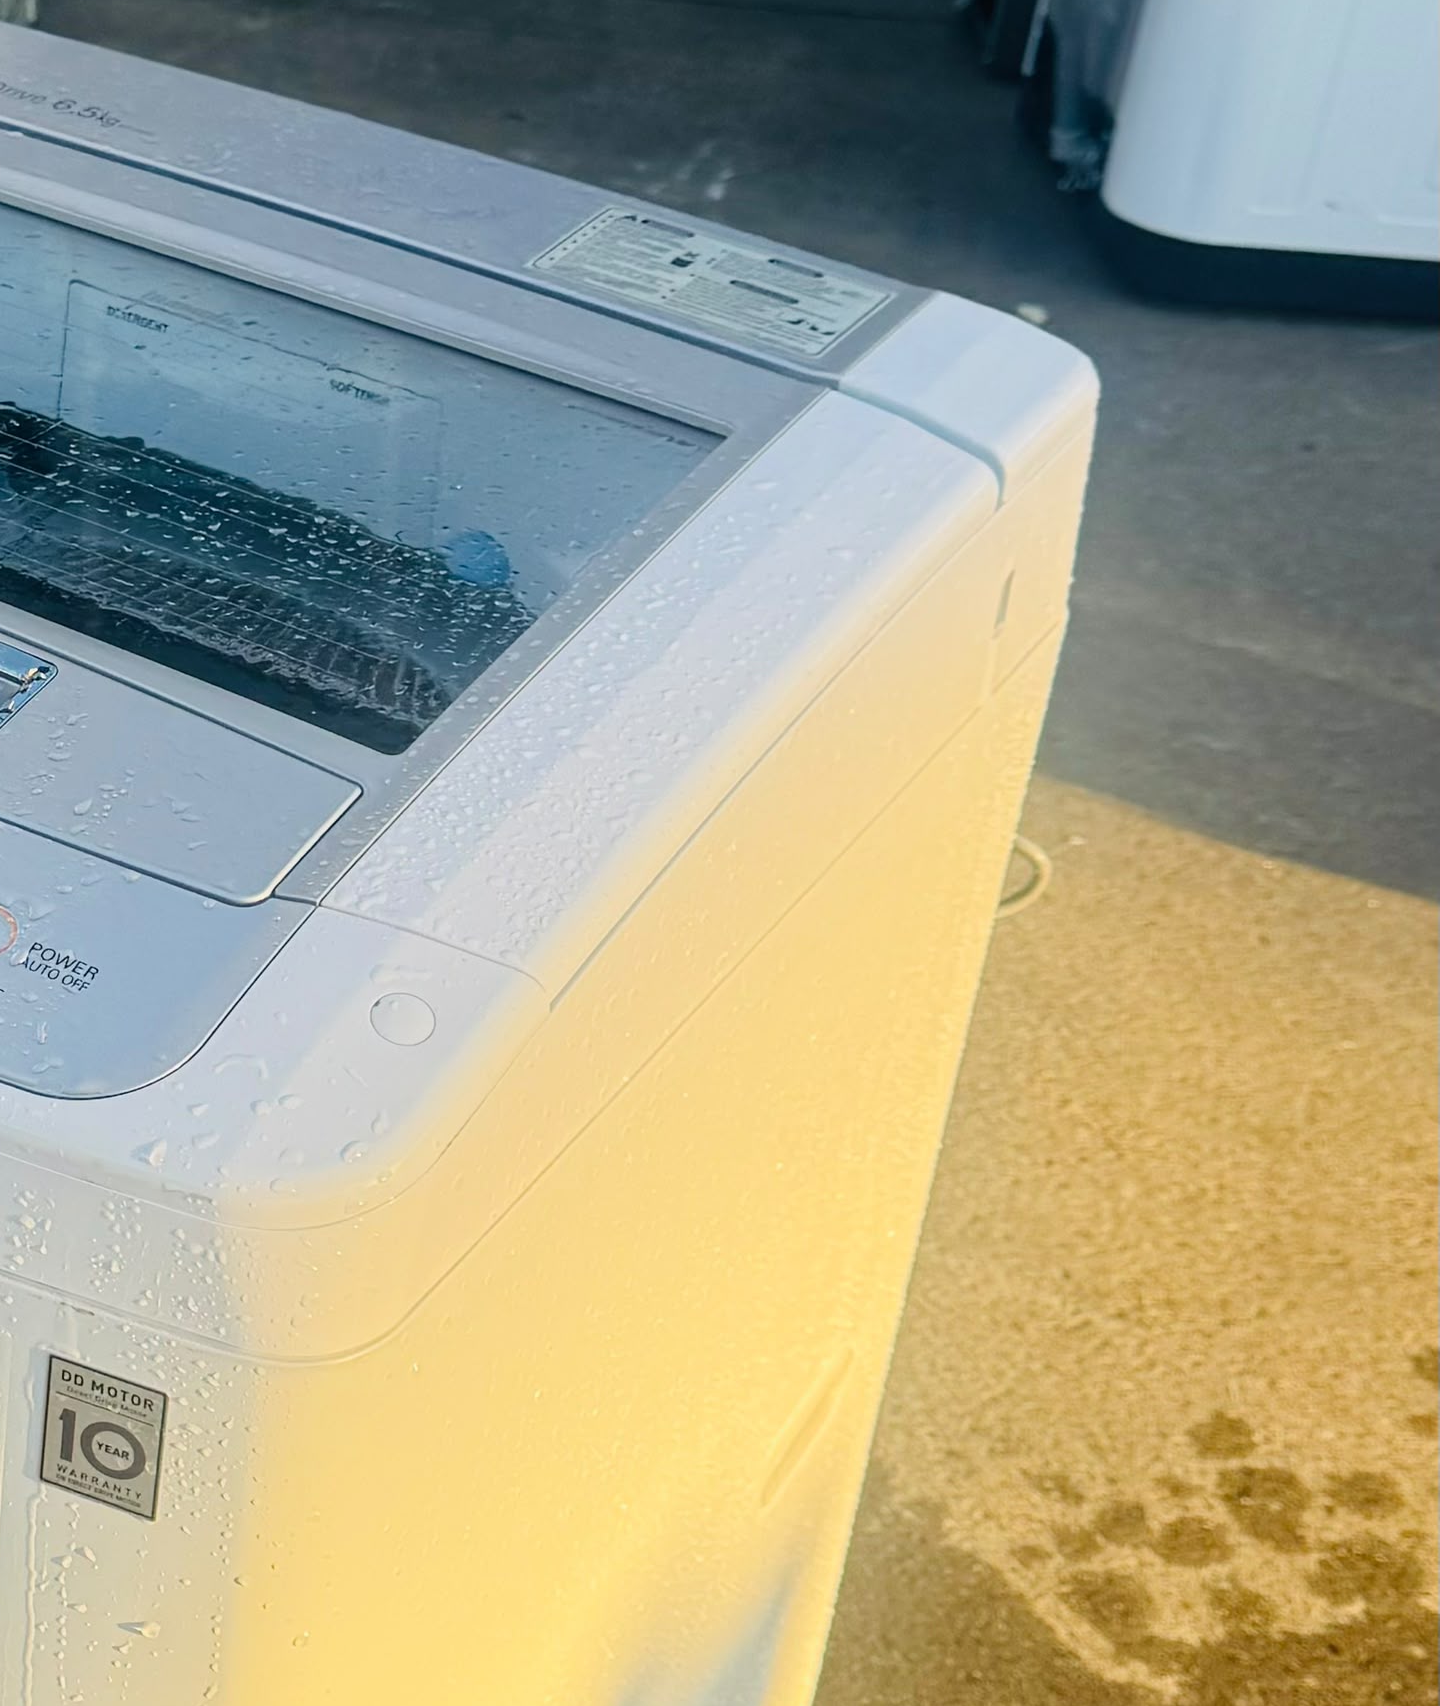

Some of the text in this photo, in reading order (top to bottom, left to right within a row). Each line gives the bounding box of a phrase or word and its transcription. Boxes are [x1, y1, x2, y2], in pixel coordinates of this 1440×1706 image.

[21, 957, 91, 992] AUTO OFF
[28, 942, 99, 980] POWER
[61, 1369, 154, 1412] DD MOTOR
[59, 1408, 146, 1480] 10
[96, 1440, 130, 1461] YEAR
[56, 1463, 142, 1500] WARRANTY
